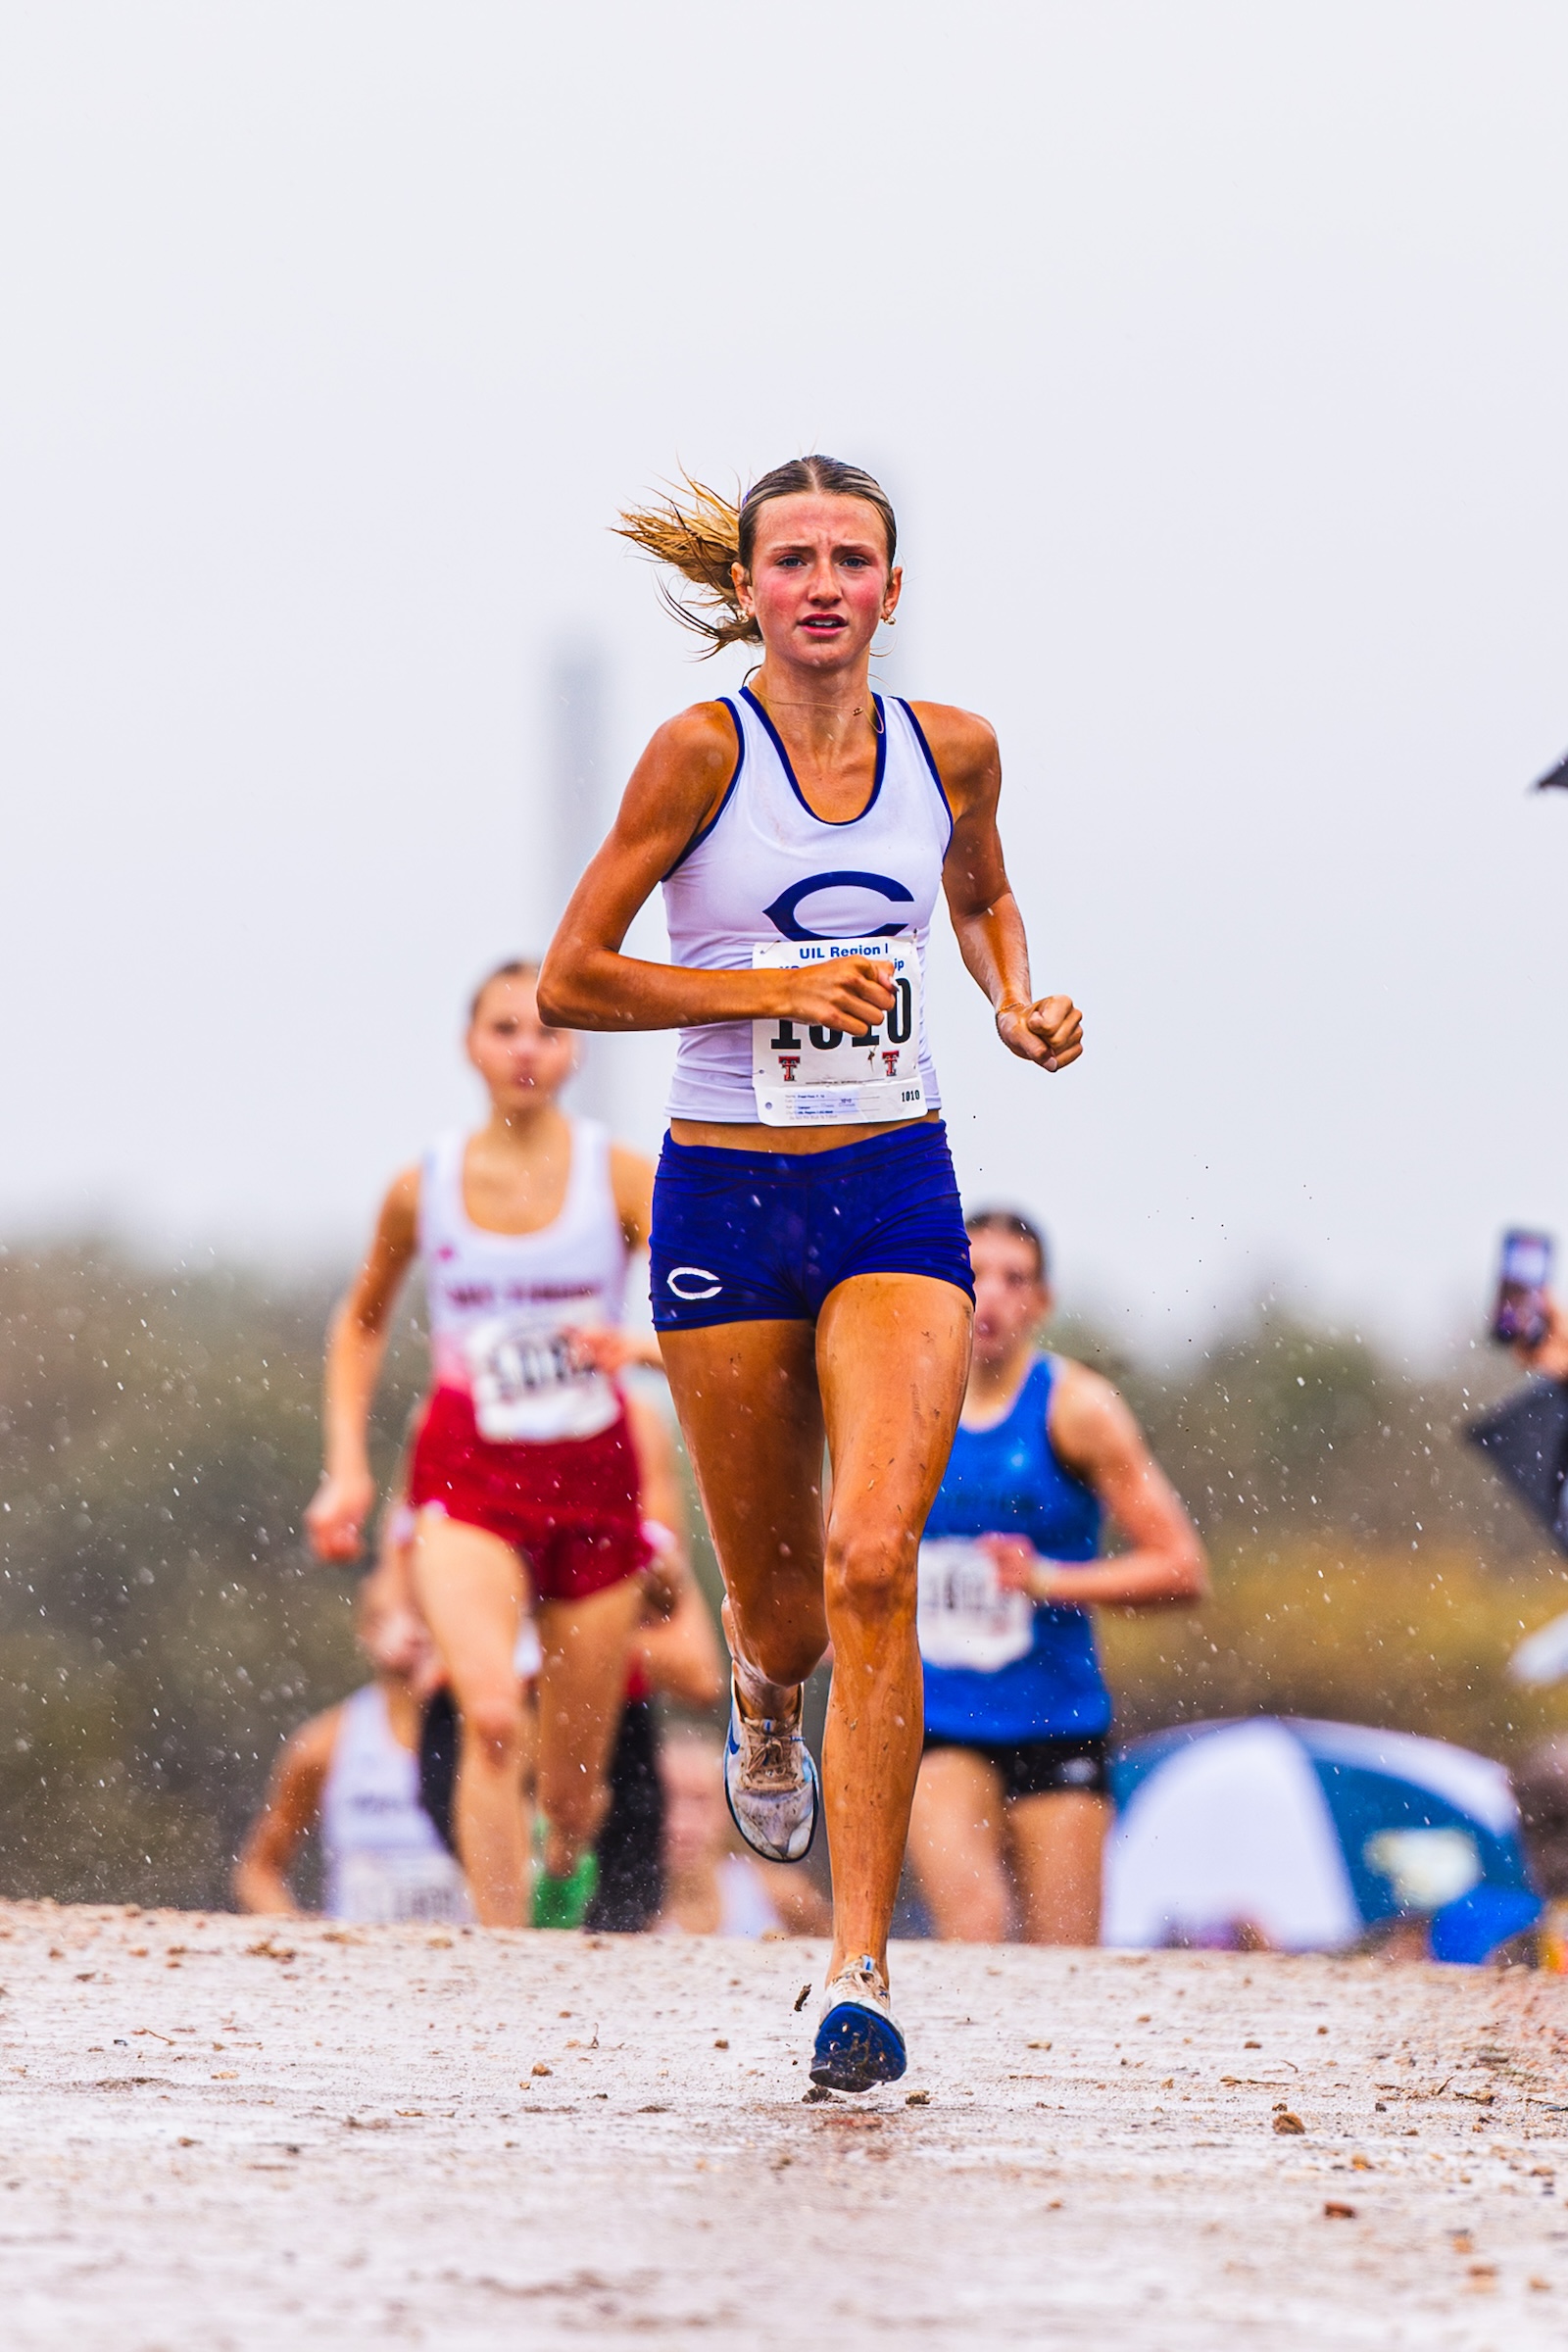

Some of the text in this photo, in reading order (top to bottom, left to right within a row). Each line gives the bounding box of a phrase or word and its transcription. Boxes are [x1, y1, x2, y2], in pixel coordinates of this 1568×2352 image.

[761, 870, 914, 942] C
[800, 947, 825, 959] UIL
[902, 1089, 920, 1102] 1010
[666, 1266, 723, 1300] C
